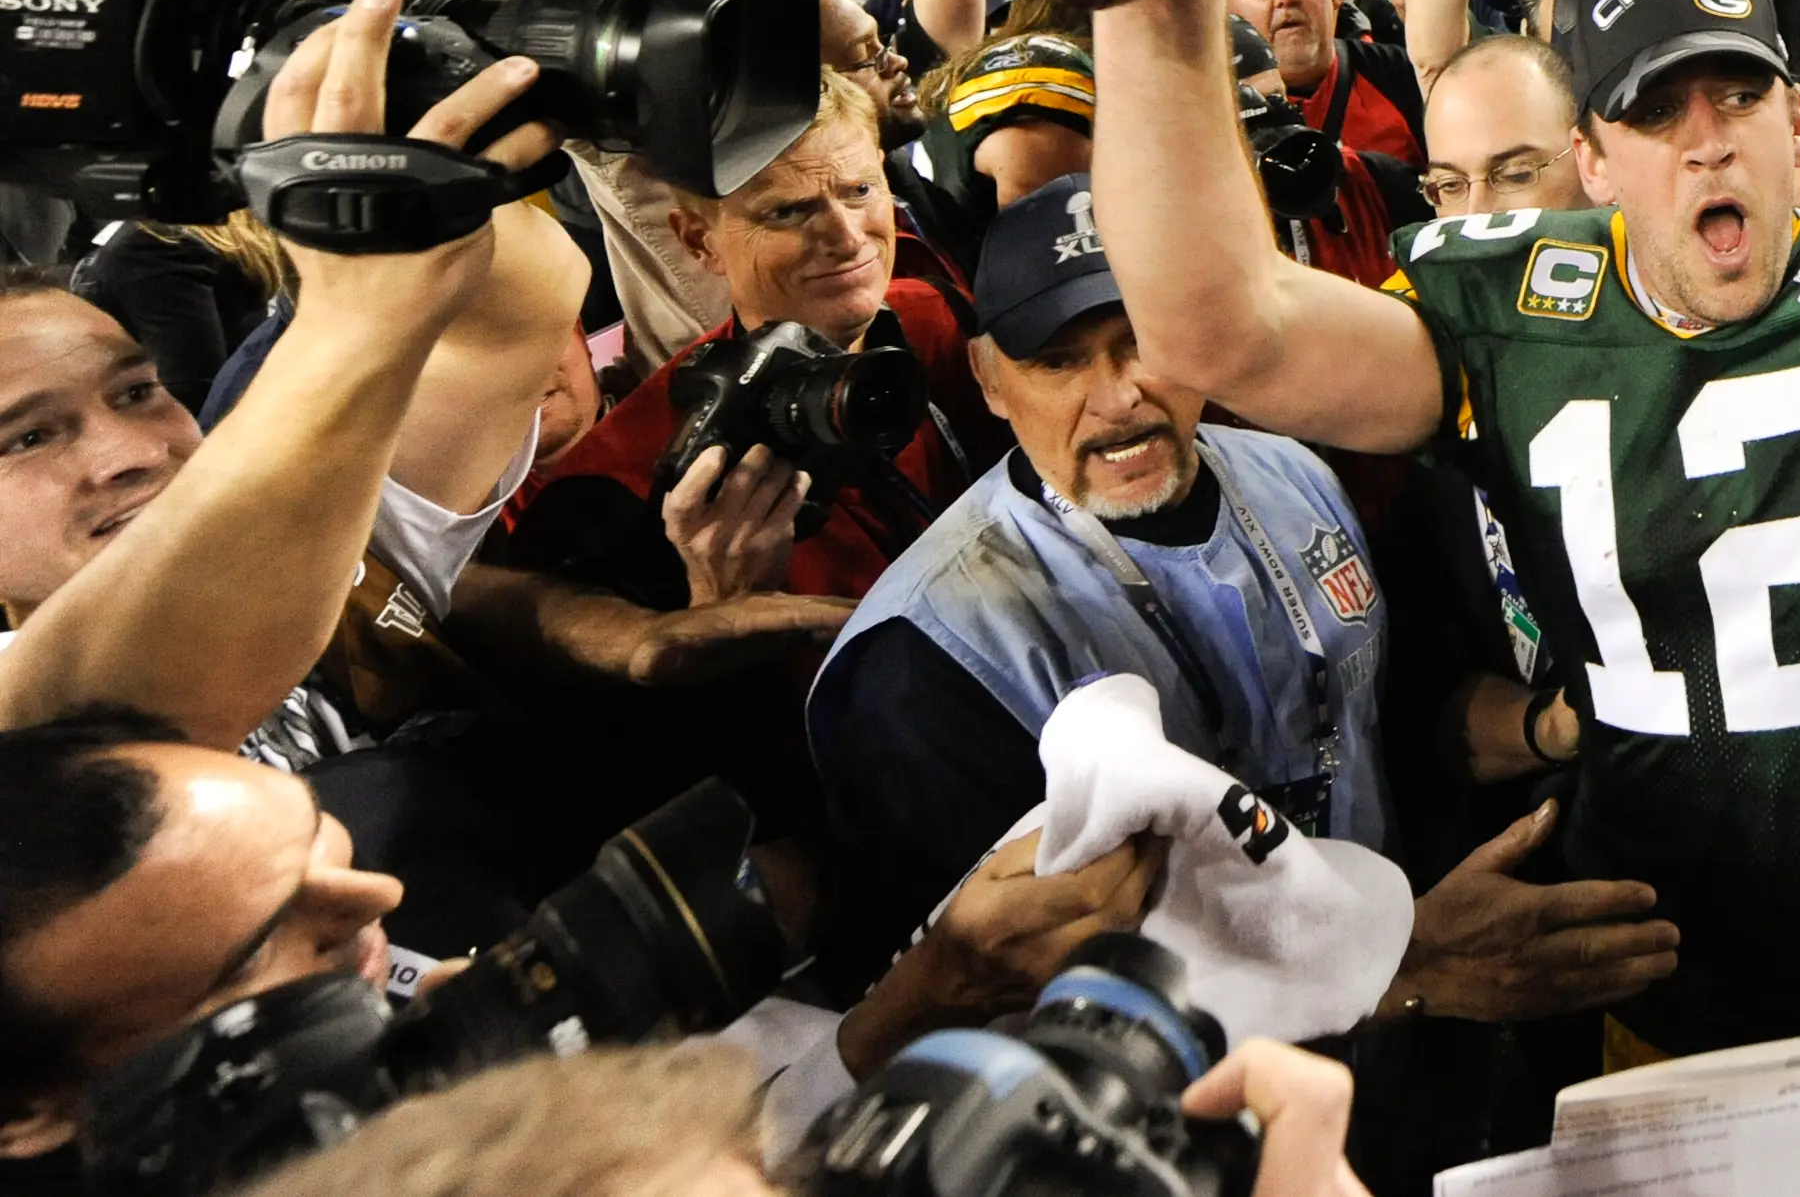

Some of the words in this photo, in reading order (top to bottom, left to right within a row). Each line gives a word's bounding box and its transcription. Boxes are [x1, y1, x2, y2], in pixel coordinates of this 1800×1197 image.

[301, 149, 408, 172] Canon
[1052, 236, 1105, 265] XL
[1530, 247, 1600, 299] C
[1047, 490, 1073, 515] XLV
[1238, 506, 1259, 533] XLV
[1258, 538, 1285, 580] BOWL
[1323, 560, 1373, 614] NFL
[1283, 585, 1312, 640] SUPER
